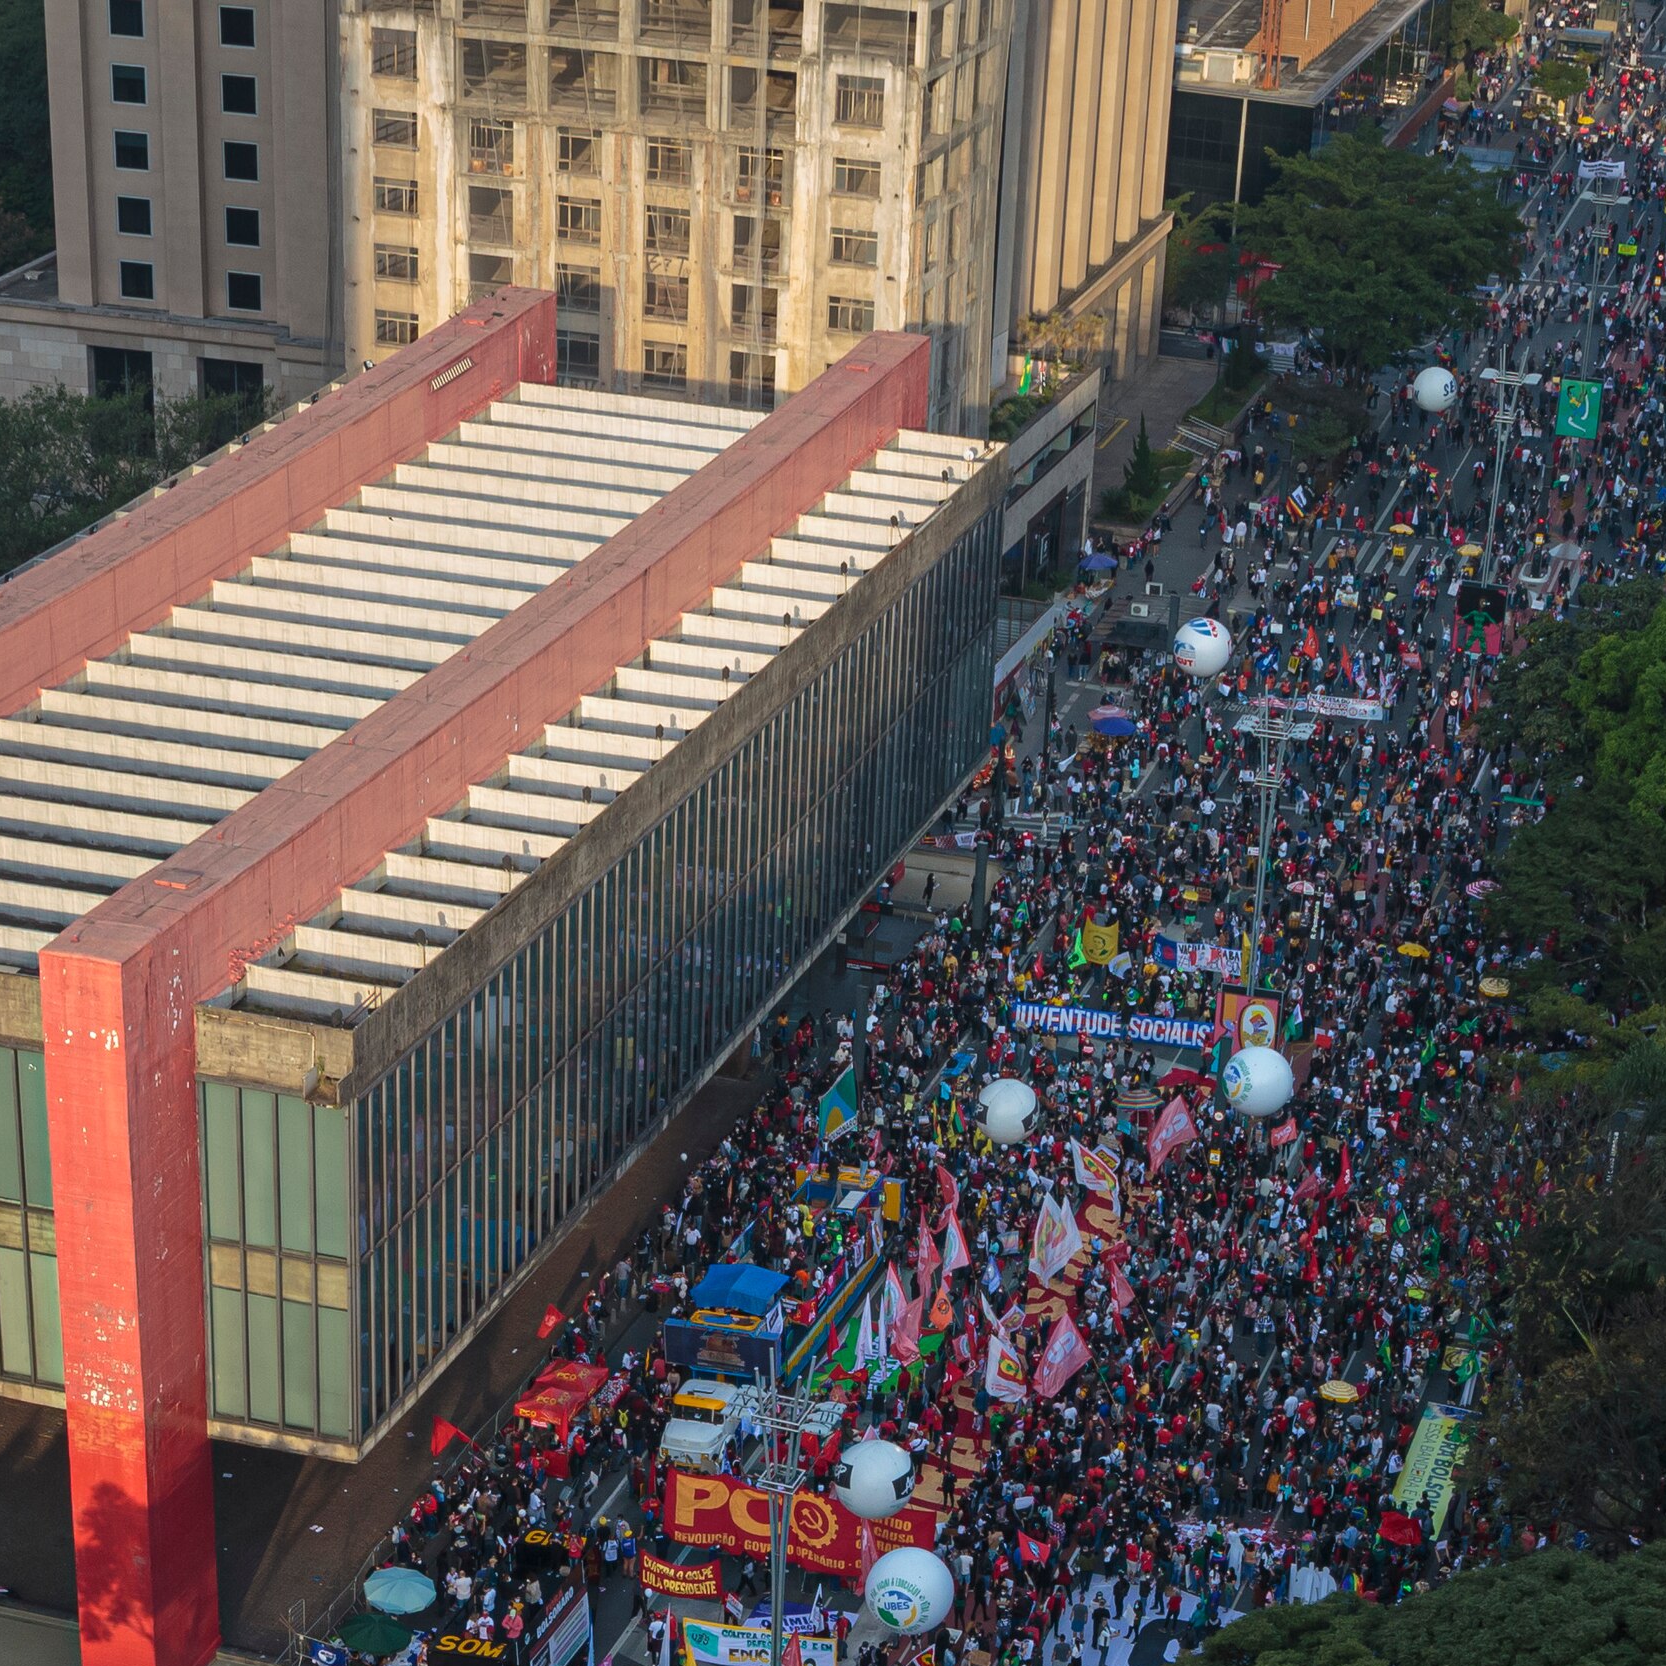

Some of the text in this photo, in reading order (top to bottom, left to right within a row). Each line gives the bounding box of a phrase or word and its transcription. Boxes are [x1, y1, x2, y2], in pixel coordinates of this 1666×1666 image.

[1013, 1004, 1122, 1036] JUVENTUDE
[874, 1526, 914, 1544] CAUSA
[674, 1531, 736, 1547] REVOLUÇÃO
[796, 1546, 845, 1570] OPERÁRIO
[642, 1569, 717, 1595] LULA PRESIDENTE
[685, 1565, 713, 1580] GOLPE
[536, 1585, 574, 1639] BOLSONARO
[884, 1601, 910, 1610] UBES
[722, 1630, 758, 1639] CONTRA
[435, 1635, 507, 1658] SOM
